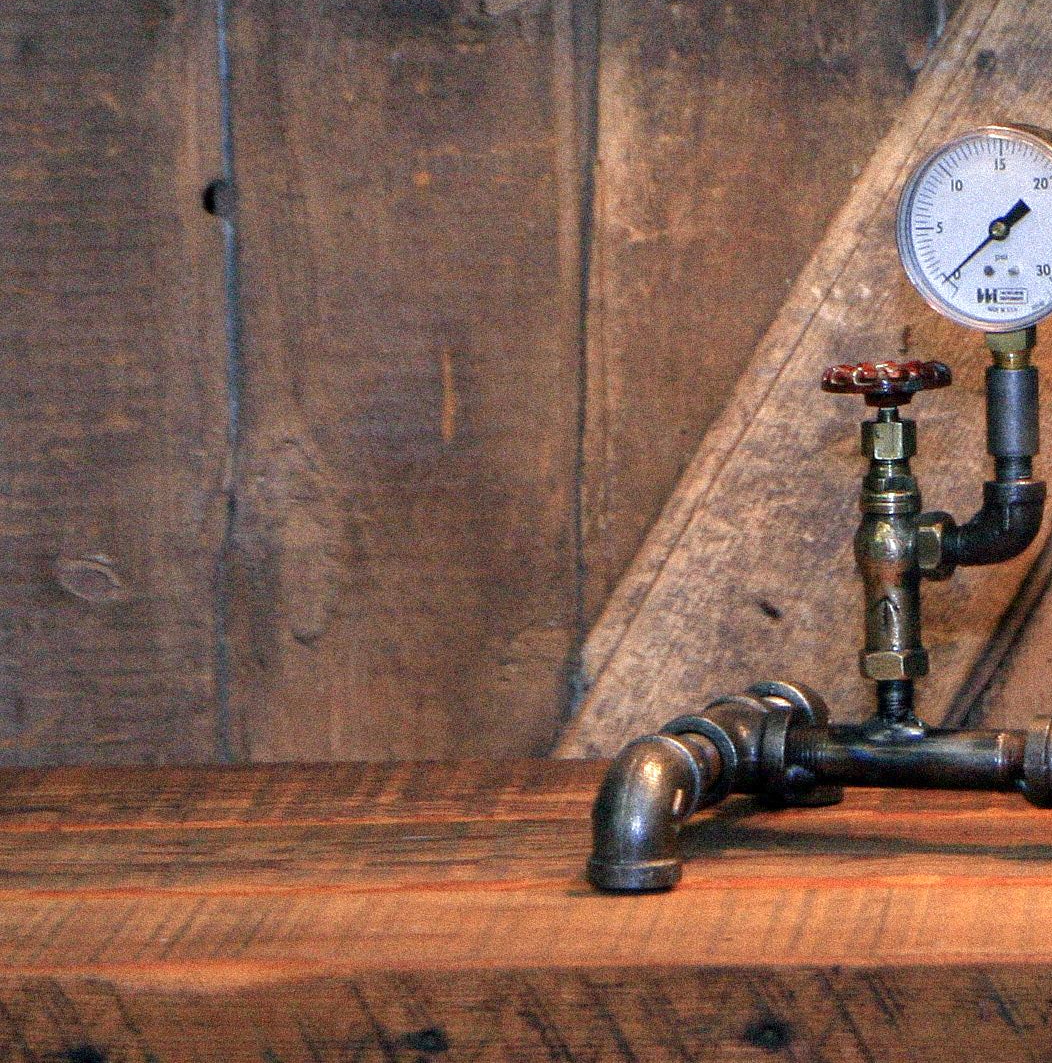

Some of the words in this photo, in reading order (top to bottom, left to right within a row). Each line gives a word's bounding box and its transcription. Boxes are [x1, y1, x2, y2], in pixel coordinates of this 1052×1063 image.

[994, 159, 1006, 171] 15
[951, 179, 963, 192] 10
[1033, 177, 1049, 190] 20
[936, 221, 943, 234] 5
[1036, 264, 1051, 277] 30
